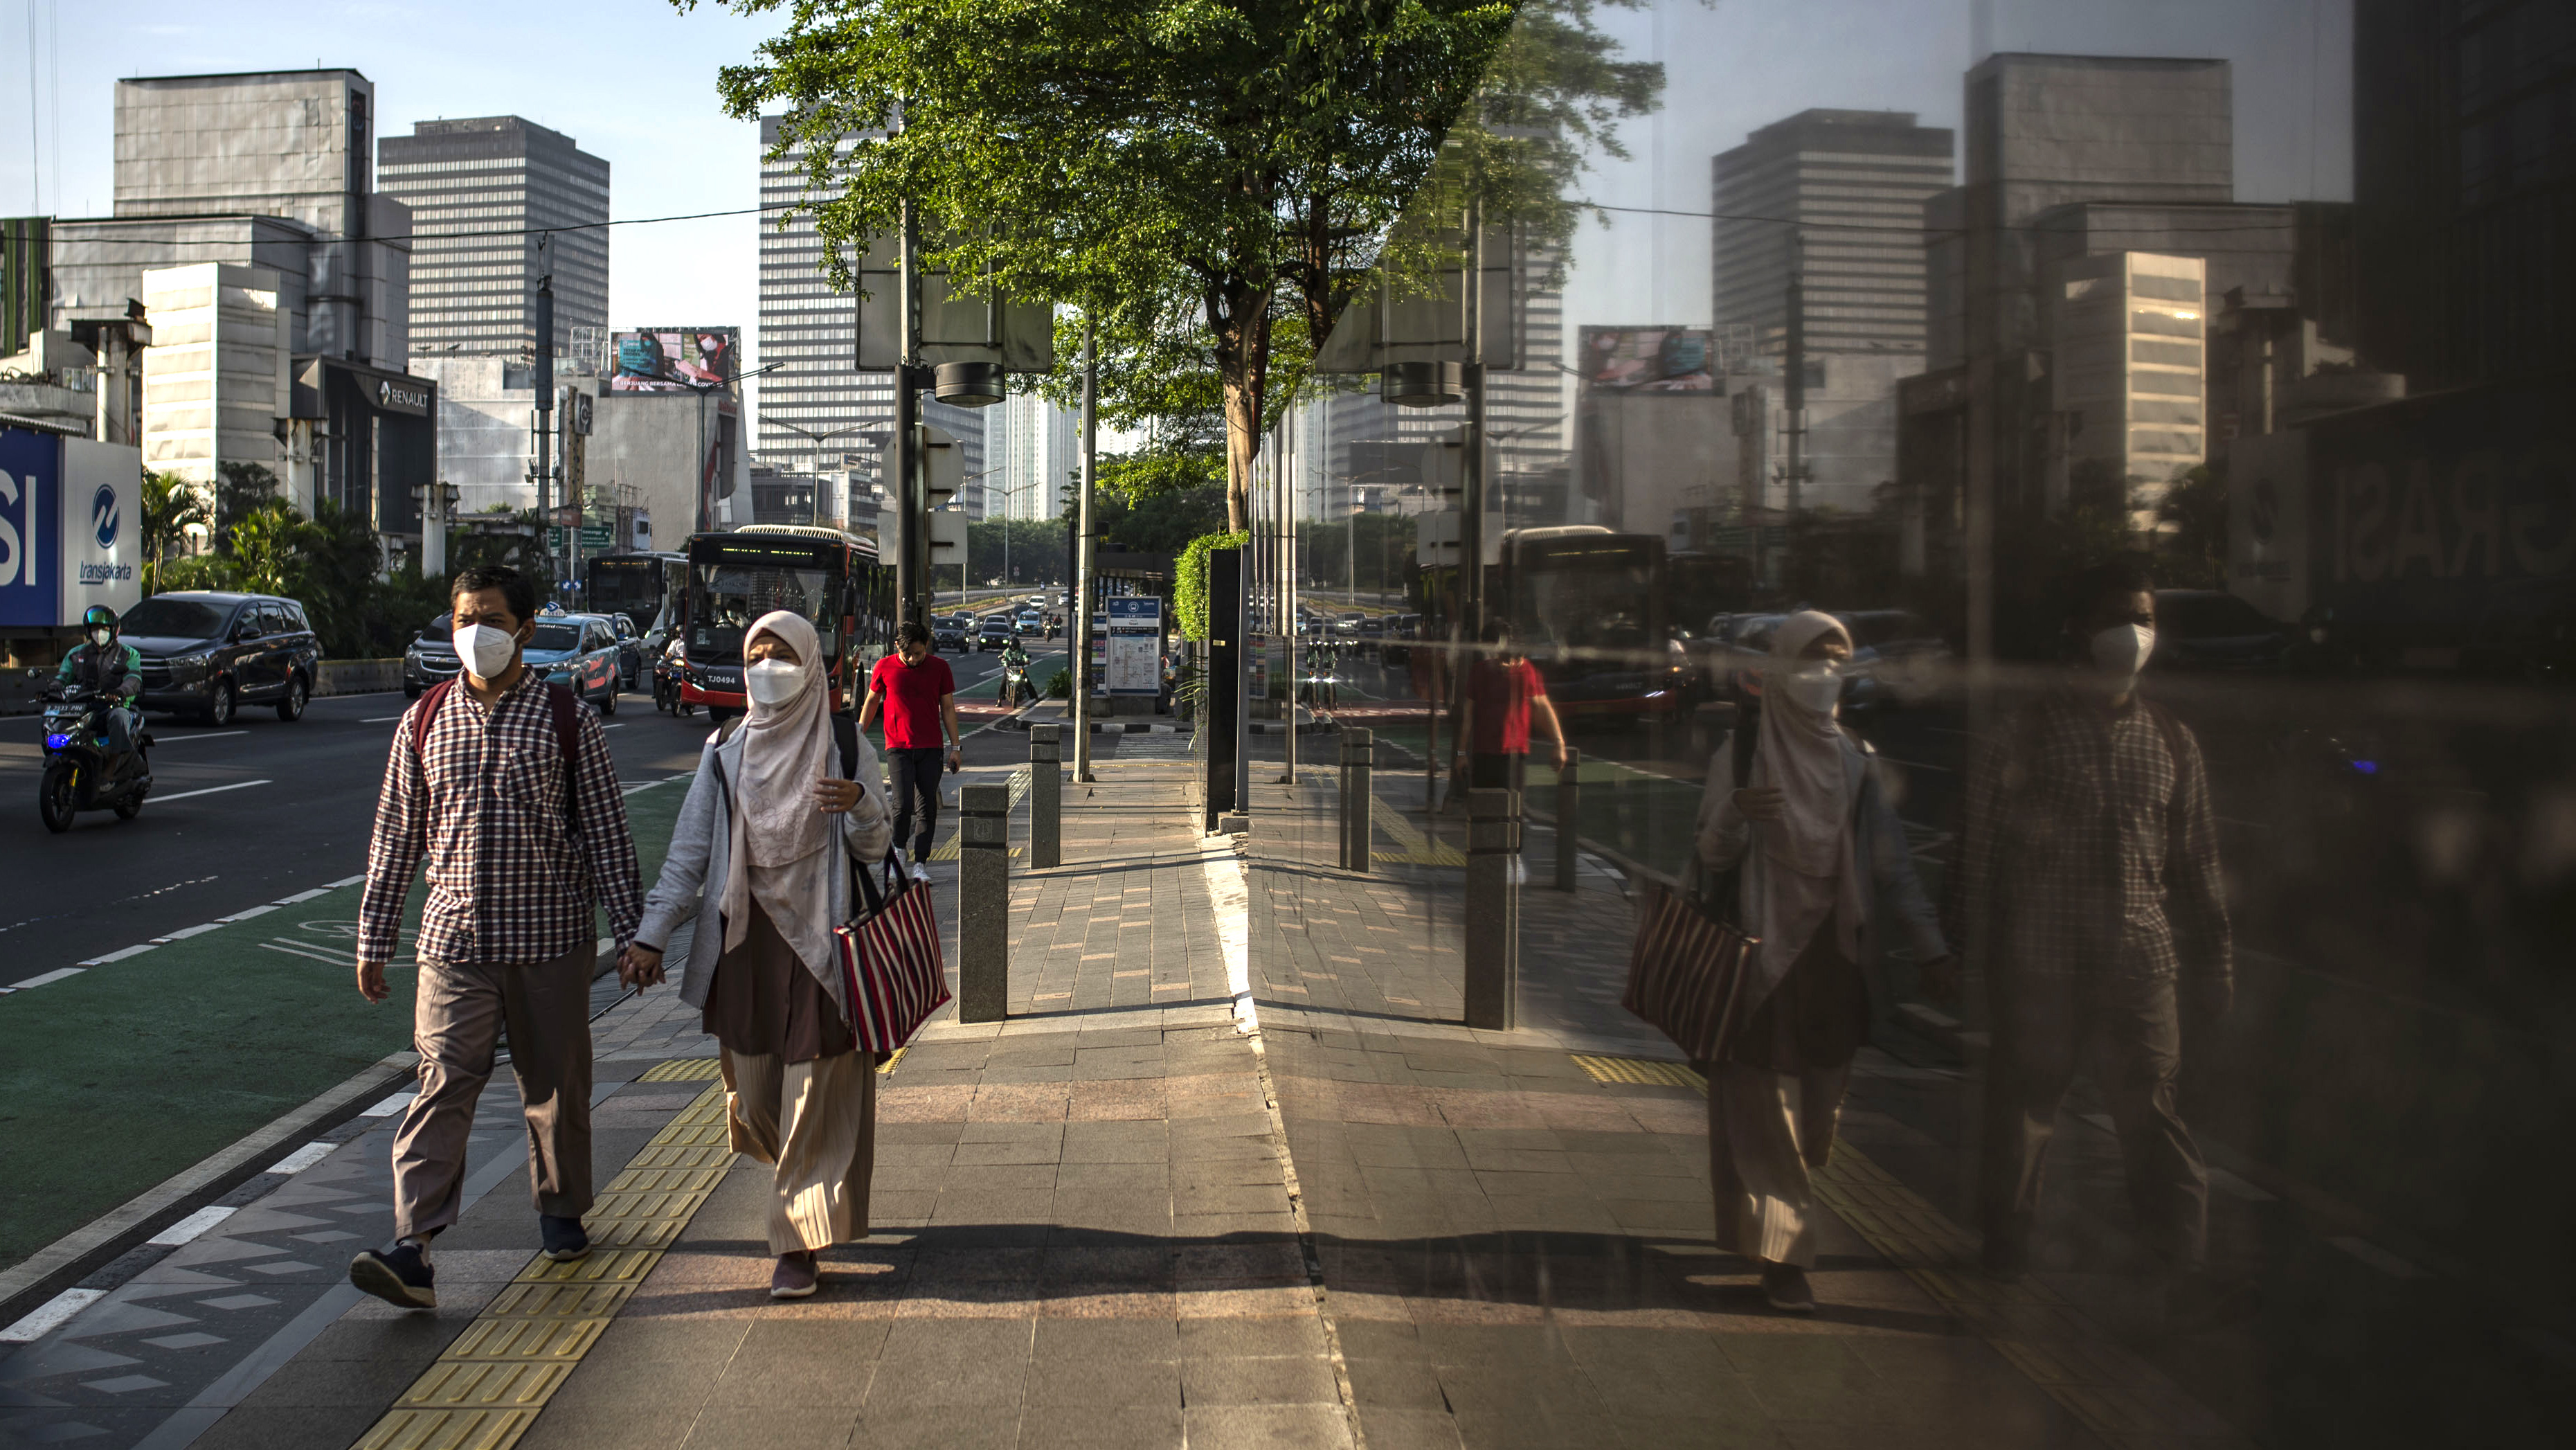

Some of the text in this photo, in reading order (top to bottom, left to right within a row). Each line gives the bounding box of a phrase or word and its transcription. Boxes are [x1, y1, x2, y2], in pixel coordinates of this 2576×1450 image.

[392, 388, 428, 408] RENAULT
[80, 560, 131, 584] transjakarta
[708, 675, 735, 684] TJ0494
